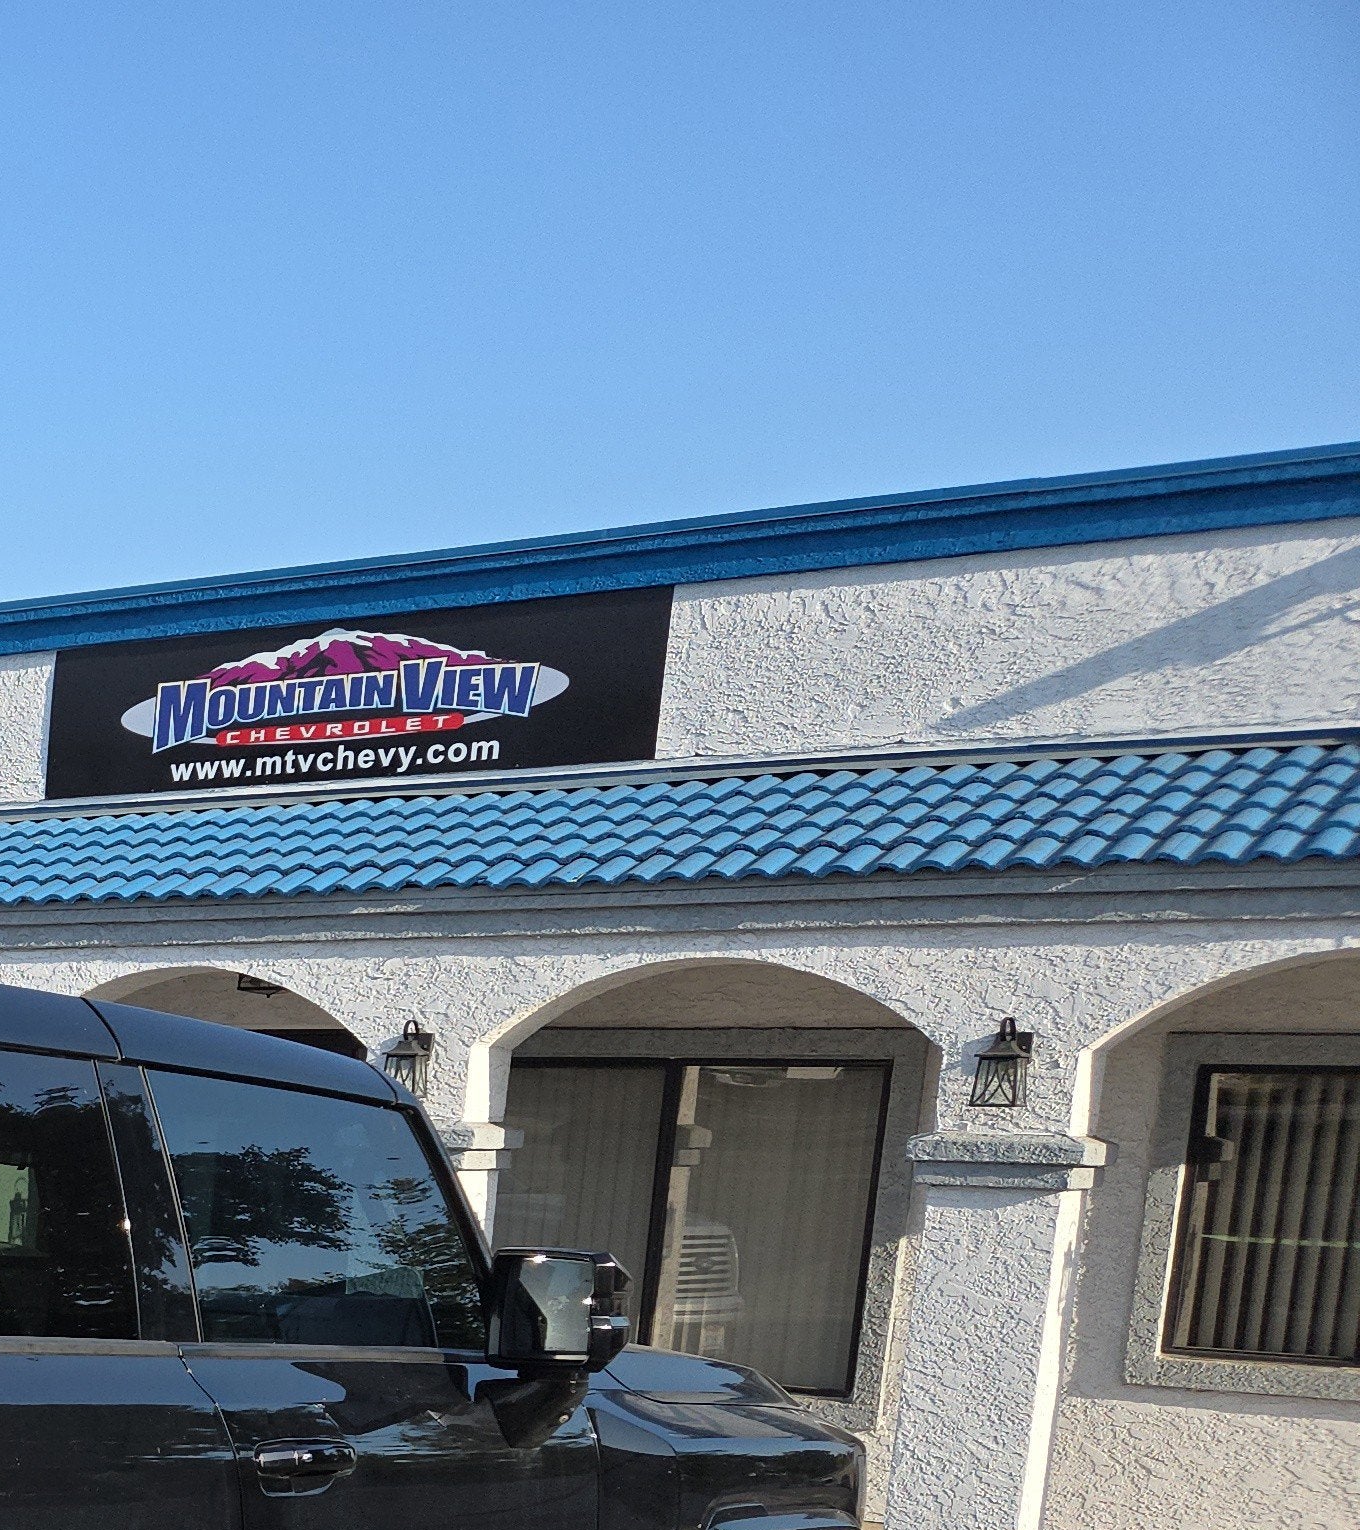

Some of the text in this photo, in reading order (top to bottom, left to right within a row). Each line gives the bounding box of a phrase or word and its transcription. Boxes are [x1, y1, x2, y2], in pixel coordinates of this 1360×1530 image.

[152, 657, 540, 754] MOUNTAIN VIEW
[225, 715, 451, 744] CHEVROLET
[170, 740, 500, 782] www.mtvchevy.com
